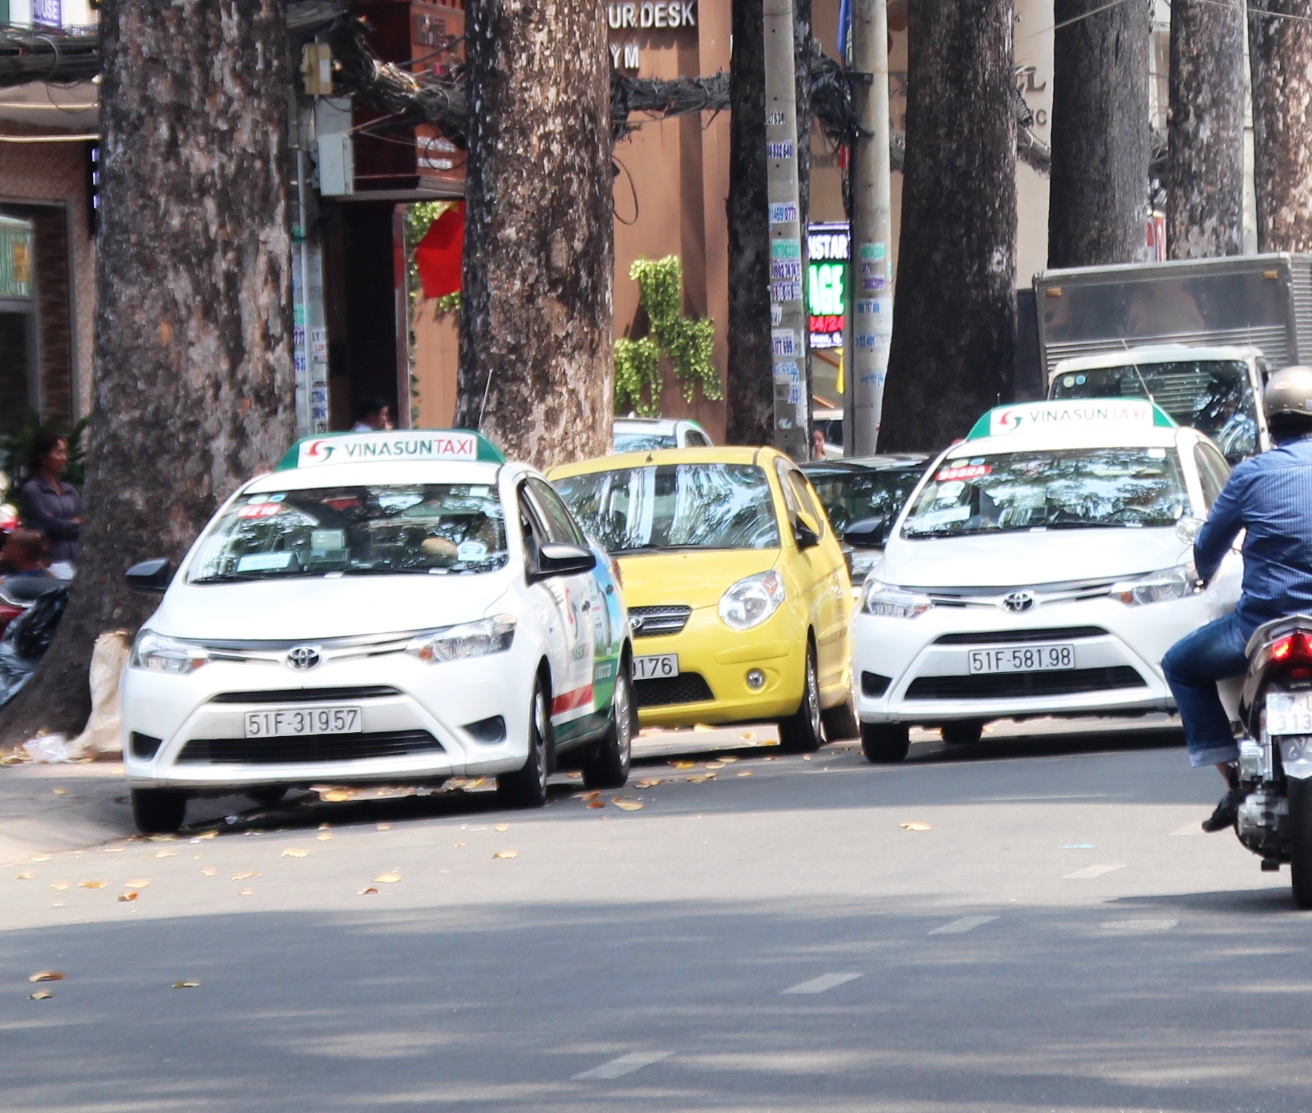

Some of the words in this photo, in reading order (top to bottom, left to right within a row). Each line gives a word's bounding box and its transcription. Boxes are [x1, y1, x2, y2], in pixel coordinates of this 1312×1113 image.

[640, 0, 695, 29] DESK
[632, 657, 673, 678] 176
[972, 647, 1071, 672] 51F-581.98
[248, 709, 358, 735] 51F-319.57
